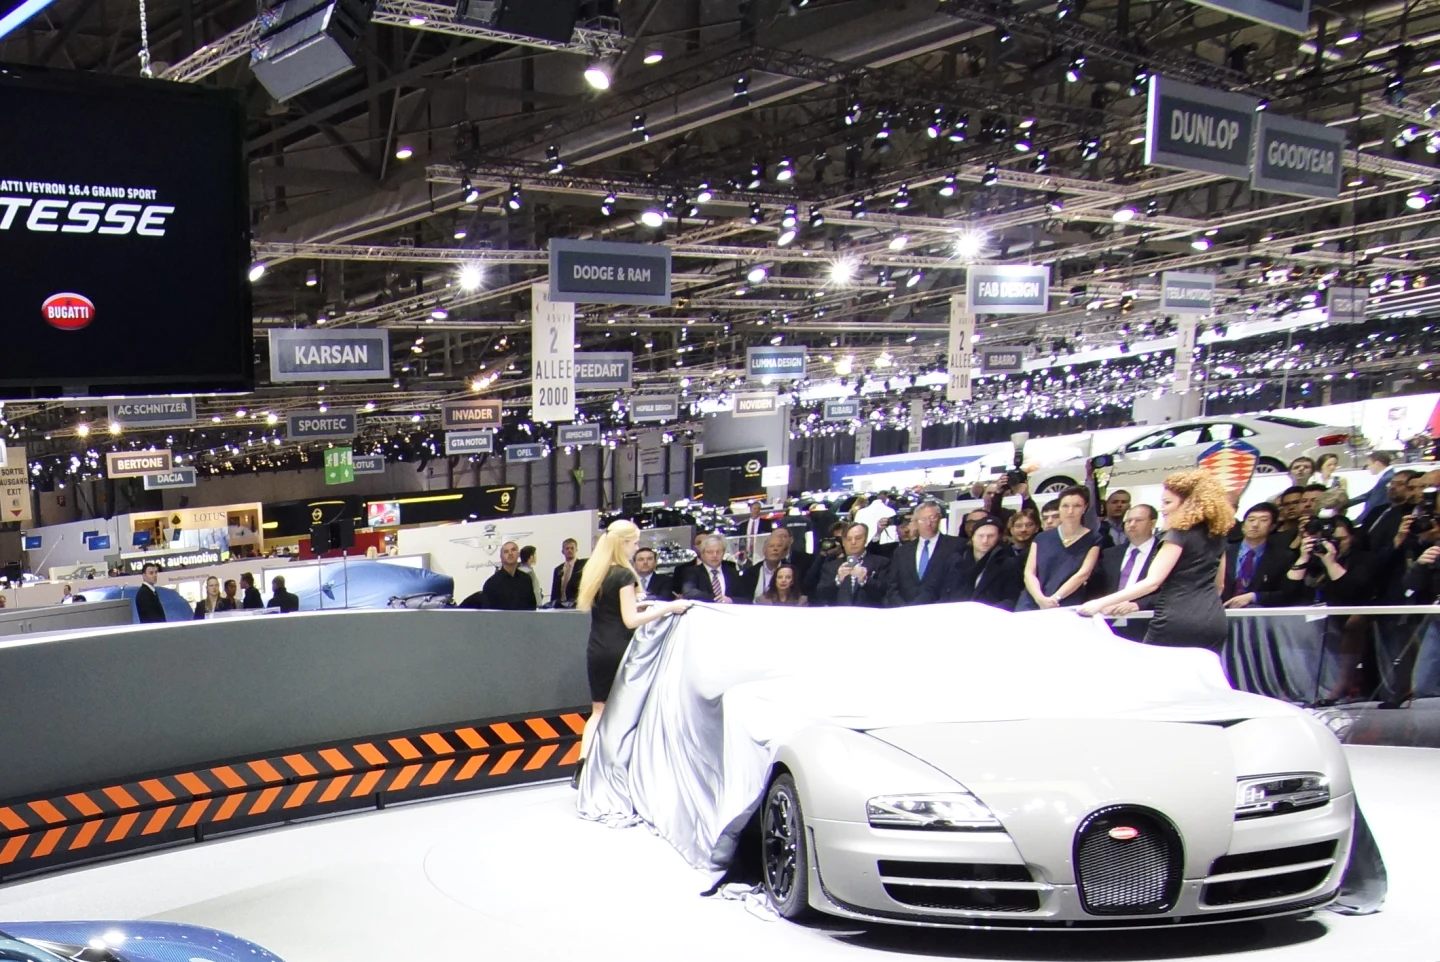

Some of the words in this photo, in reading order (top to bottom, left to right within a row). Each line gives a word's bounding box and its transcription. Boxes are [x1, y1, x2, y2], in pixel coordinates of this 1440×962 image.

[1170, 109, 1240, 150] DUNLOP
[1268, 140, 1335, 174] GOODYEAR
[25, 181, 66, 196] VEYRON
[68, 184, 90, 197] 16.4
[91, 185, 126, 199] GRAND
[127, 187, 158, 200] SPORT
[573, 264, 614, 281] DODGE
[617, 266, 625, 281] &
[627, 267, 651, 282] RAM
[978, 281, 999, 298] FAB
[1000, 282, 1039, 298] DESIGN
[47, 305, 89, 319] BUGATTI
[549, 326, 559, 354] 2
[959, 330, 965, 351] 2
[294, 344, 368, 366] KARSAN
[950, 353, 972, 369] ALLEE
[535, 359, 573, 380] ALLEE
[574, 363, 625, 378] PEEDART
[752, 358, 777, 369] LUMMA
[777, 357, 802, 368] DESIGN
[951, 374, 969, 389] 2100
[539, 387, 569, 406] 2000
[117, 404, 133, 415] AC
[134, 402, 188, 415] SCHNITZER
[452, 408, 493, 421] INVADER
[830, 405, 854, 415] SUBARU
[298, 417, 347, 432] SPORTEC
[451, 438, 464, 447] GTA
[465, 437, 488, 447] MOTOR
[516, 449, 533, 458] OPEL
[117, 457, 164, 470] BERTONE
[352, 460, 375, 470] LOTUS
[1, 467, 25, 477] SORTIE
[156, 473, 184, 484] DACIA
[0, 477, 28, 486] AUSGANG
[6, 488, 21, 496] EXIT
[193, 511, 226, 523] LOTUS
[167, 551, 219, 567] automotive
